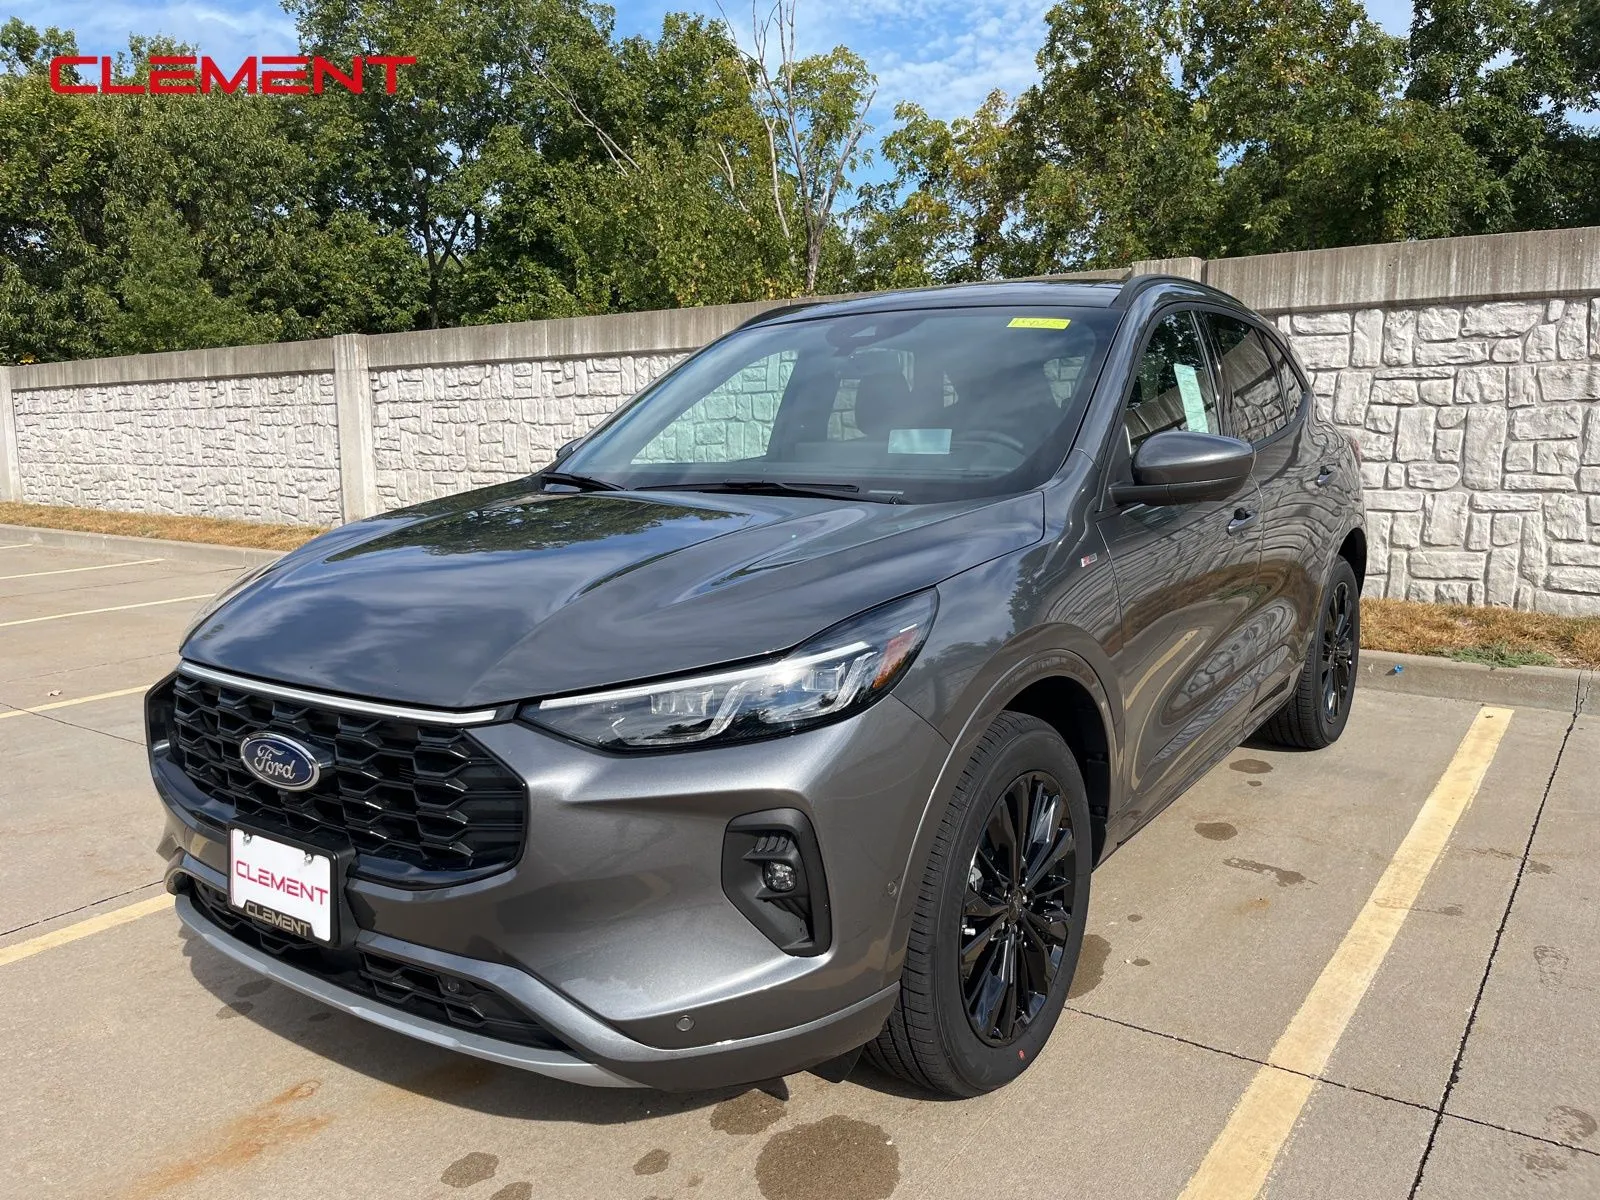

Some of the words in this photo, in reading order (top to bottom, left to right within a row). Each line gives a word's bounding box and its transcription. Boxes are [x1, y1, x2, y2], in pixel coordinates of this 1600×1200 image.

[254, 743, 296, 780] Ford
[236, 860, 329, 906] CLEMENT
[246, 902, 311, 937] CLEMENT
